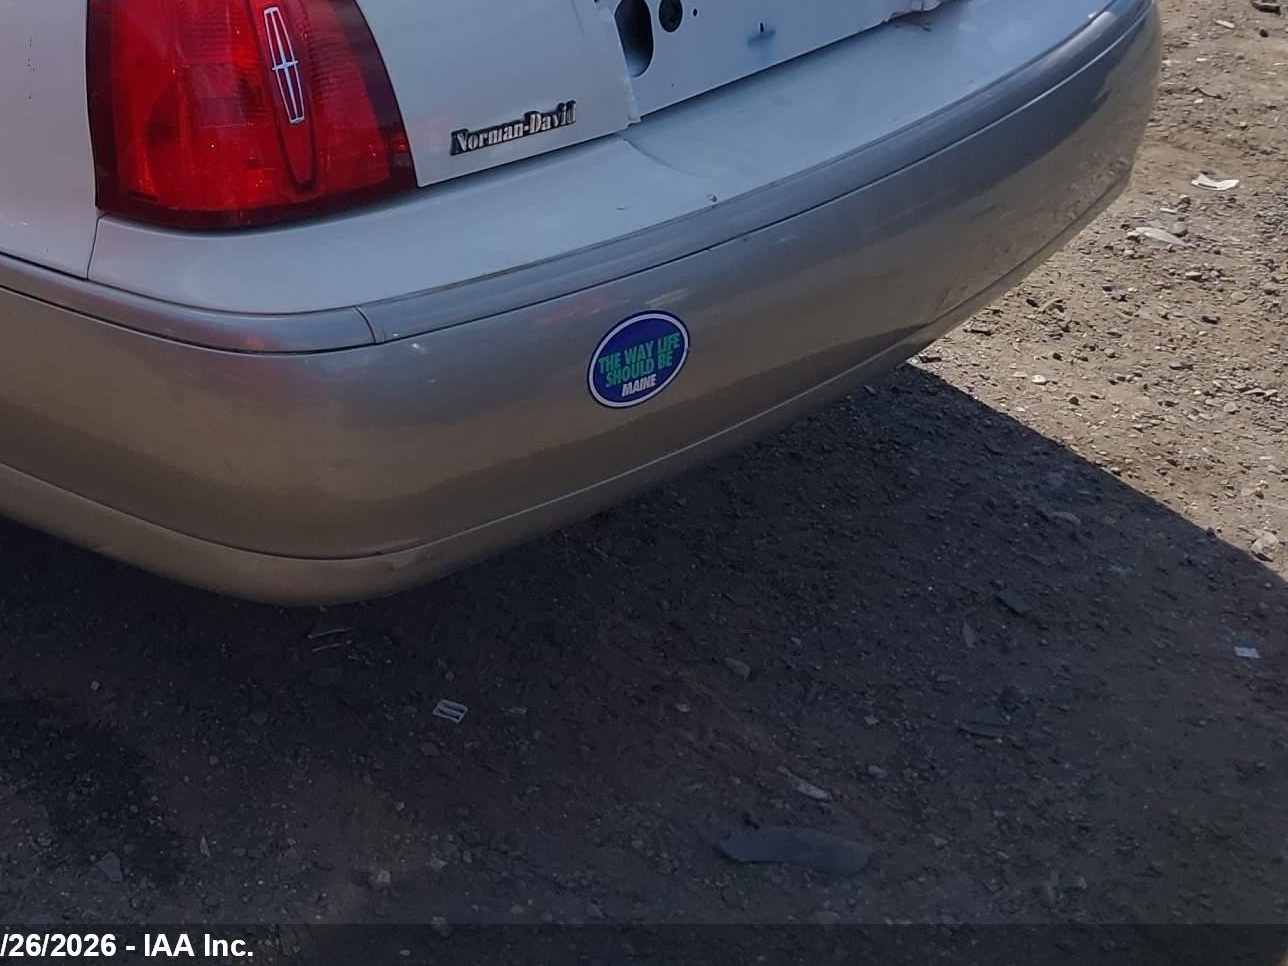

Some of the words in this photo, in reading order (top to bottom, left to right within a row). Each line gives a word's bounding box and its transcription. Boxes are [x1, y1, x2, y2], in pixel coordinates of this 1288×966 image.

[451, 100, 576, 155] Norman-David
[599, 352, 621, 374] THE
[624, 340, 654, 365] WAY
[657, 333, 681, 355] LIFE
[605, 358, 655, 388] SHOULD
[657, 351, 673, 370] BE
[621, 374, 657, 397] MAINE
